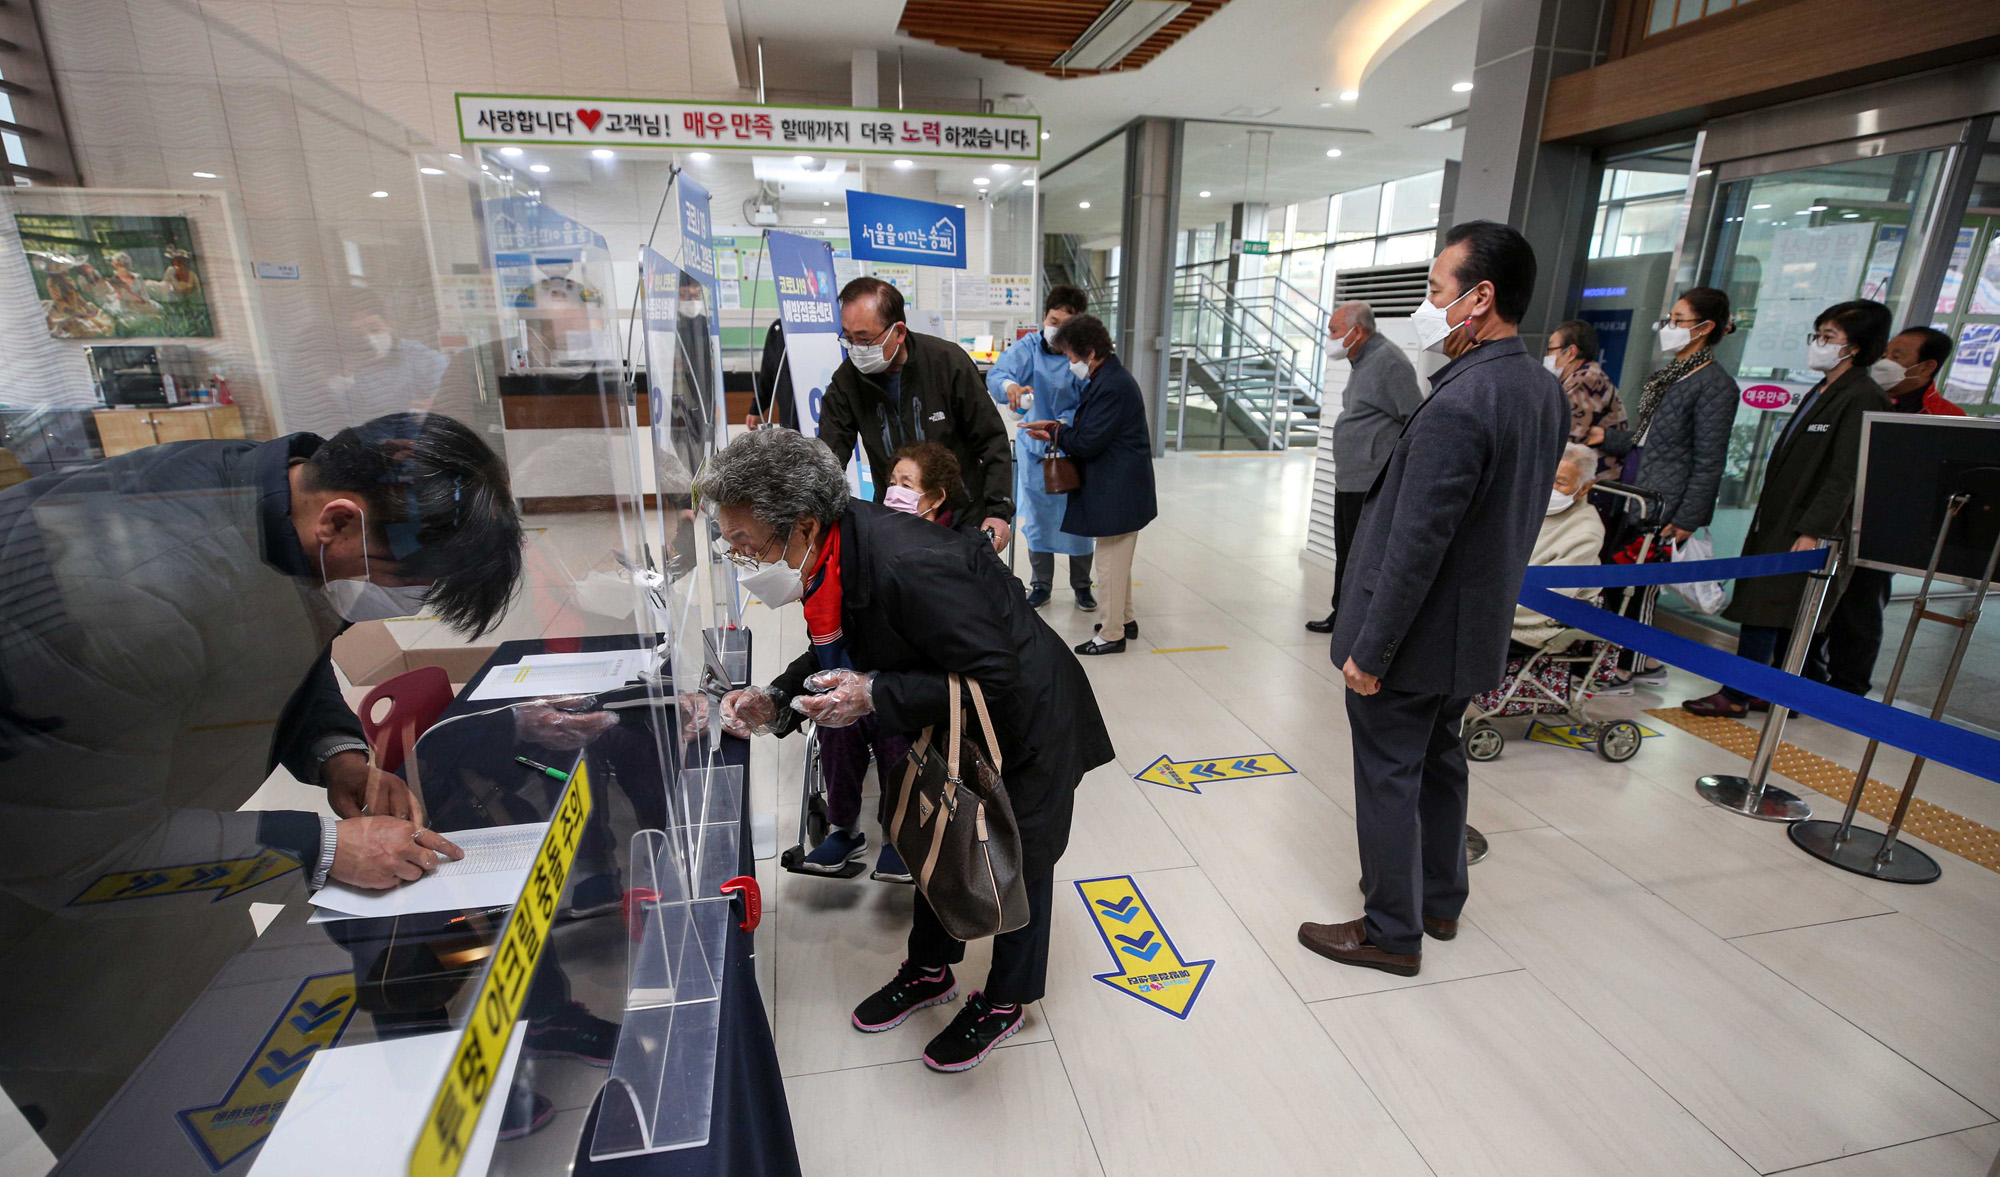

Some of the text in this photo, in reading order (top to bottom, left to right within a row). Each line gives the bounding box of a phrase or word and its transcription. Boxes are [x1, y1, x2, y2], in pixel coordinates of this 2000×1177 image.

[478, 109, 573, 133] 사랑합니다
[604, 112, 671, 137] 고객님!
[781, 119, 850, 142] 할때까지
[861, 122, 894, 144] 더욱
[862, 222, 953, 250] 서울을 이끄는 송파
[778, 275, 808, 296] 코로나19
[782, 299, 834, 323] 예방접종센터
[1806, 423, 1831, 433] MERC
[435, 1026, 488, 1166] 투명
[485, 897, 541, 1037] 아크릴
